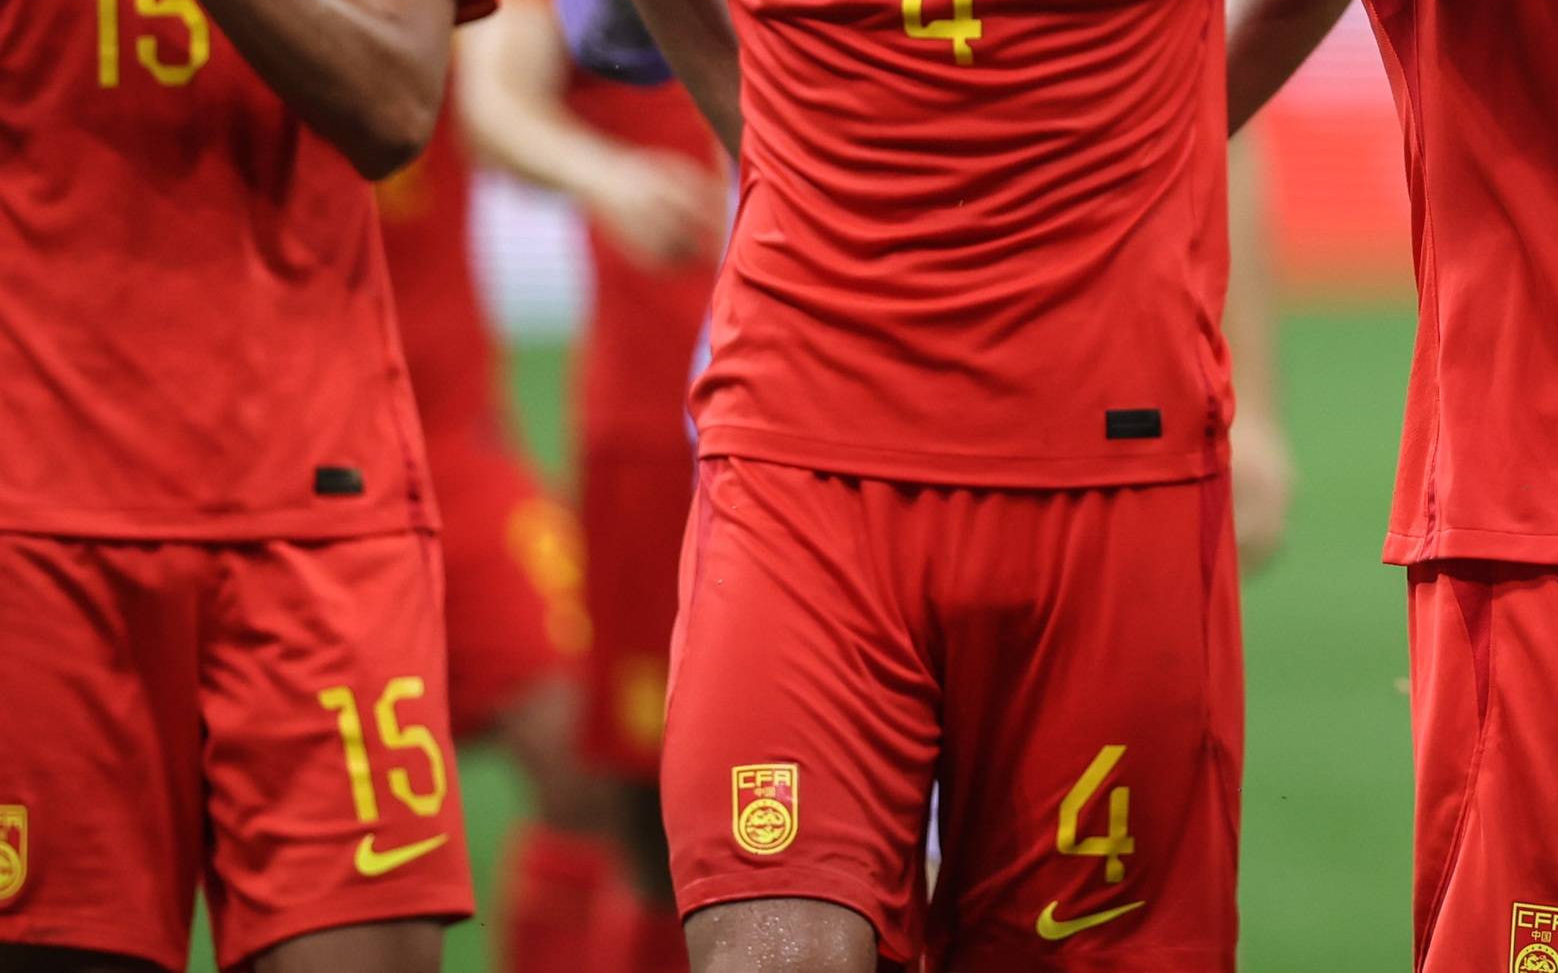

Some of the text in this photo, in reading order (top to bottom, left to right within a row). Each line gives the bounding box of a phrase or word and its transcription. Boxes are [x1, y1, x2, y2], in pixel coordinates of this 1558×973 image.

[317, 675, 448, 825] 15
[738, 770, 792, 789] CFA
[1056, 743, 1135, 884] 4
[1530, 930, 1552, 943] 中国
